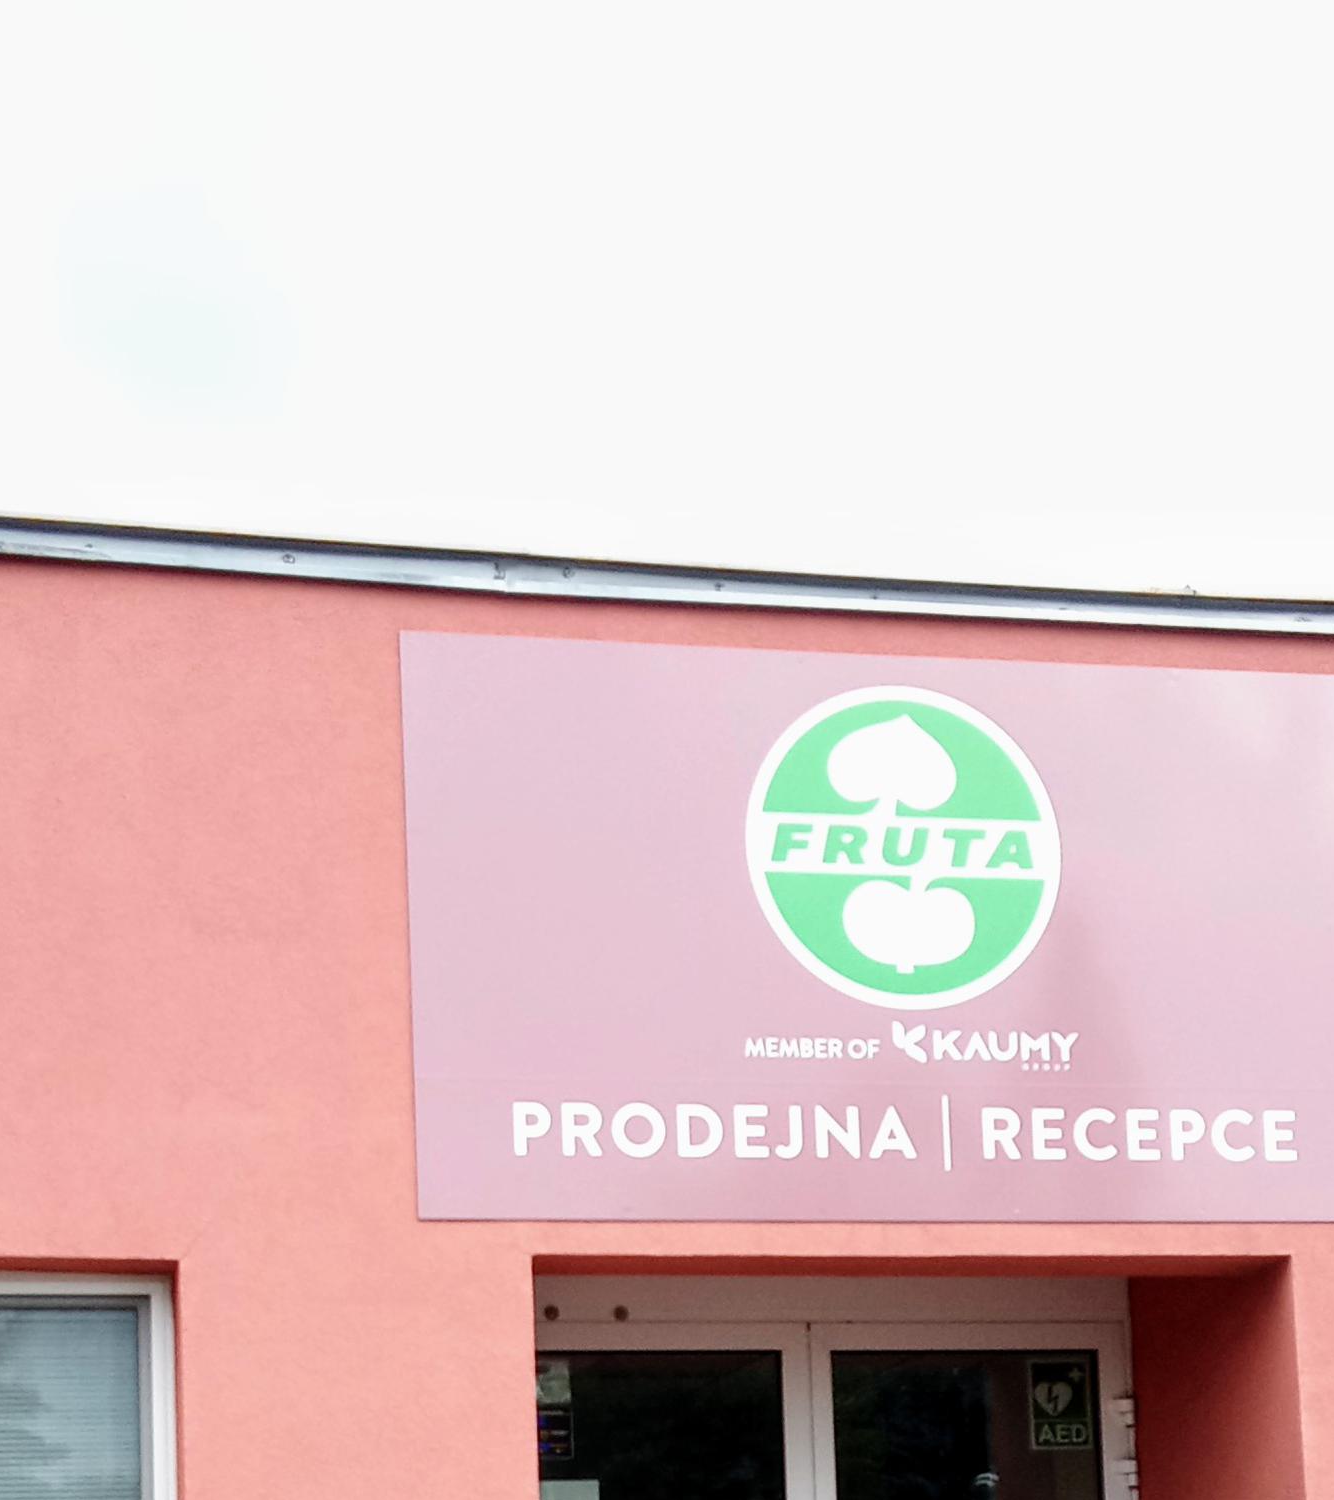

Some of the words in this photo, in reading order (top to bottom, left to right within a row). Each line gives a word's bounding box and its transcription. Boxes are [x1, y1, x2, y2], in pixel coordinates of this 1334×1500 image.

[771, 822, 1034, 870] FRUTA
[745, 1037, 843, 1059] MEMBER
[847, 1039, 880, 1059] OF
[932, 1030, 1079, 1062] KAUMY
[512, 1101, 917, 1160] PRODEJNA
[980, 1107, 1299, 1162] RECEPCE
[1038, 1424, 1087, 1443] AED
